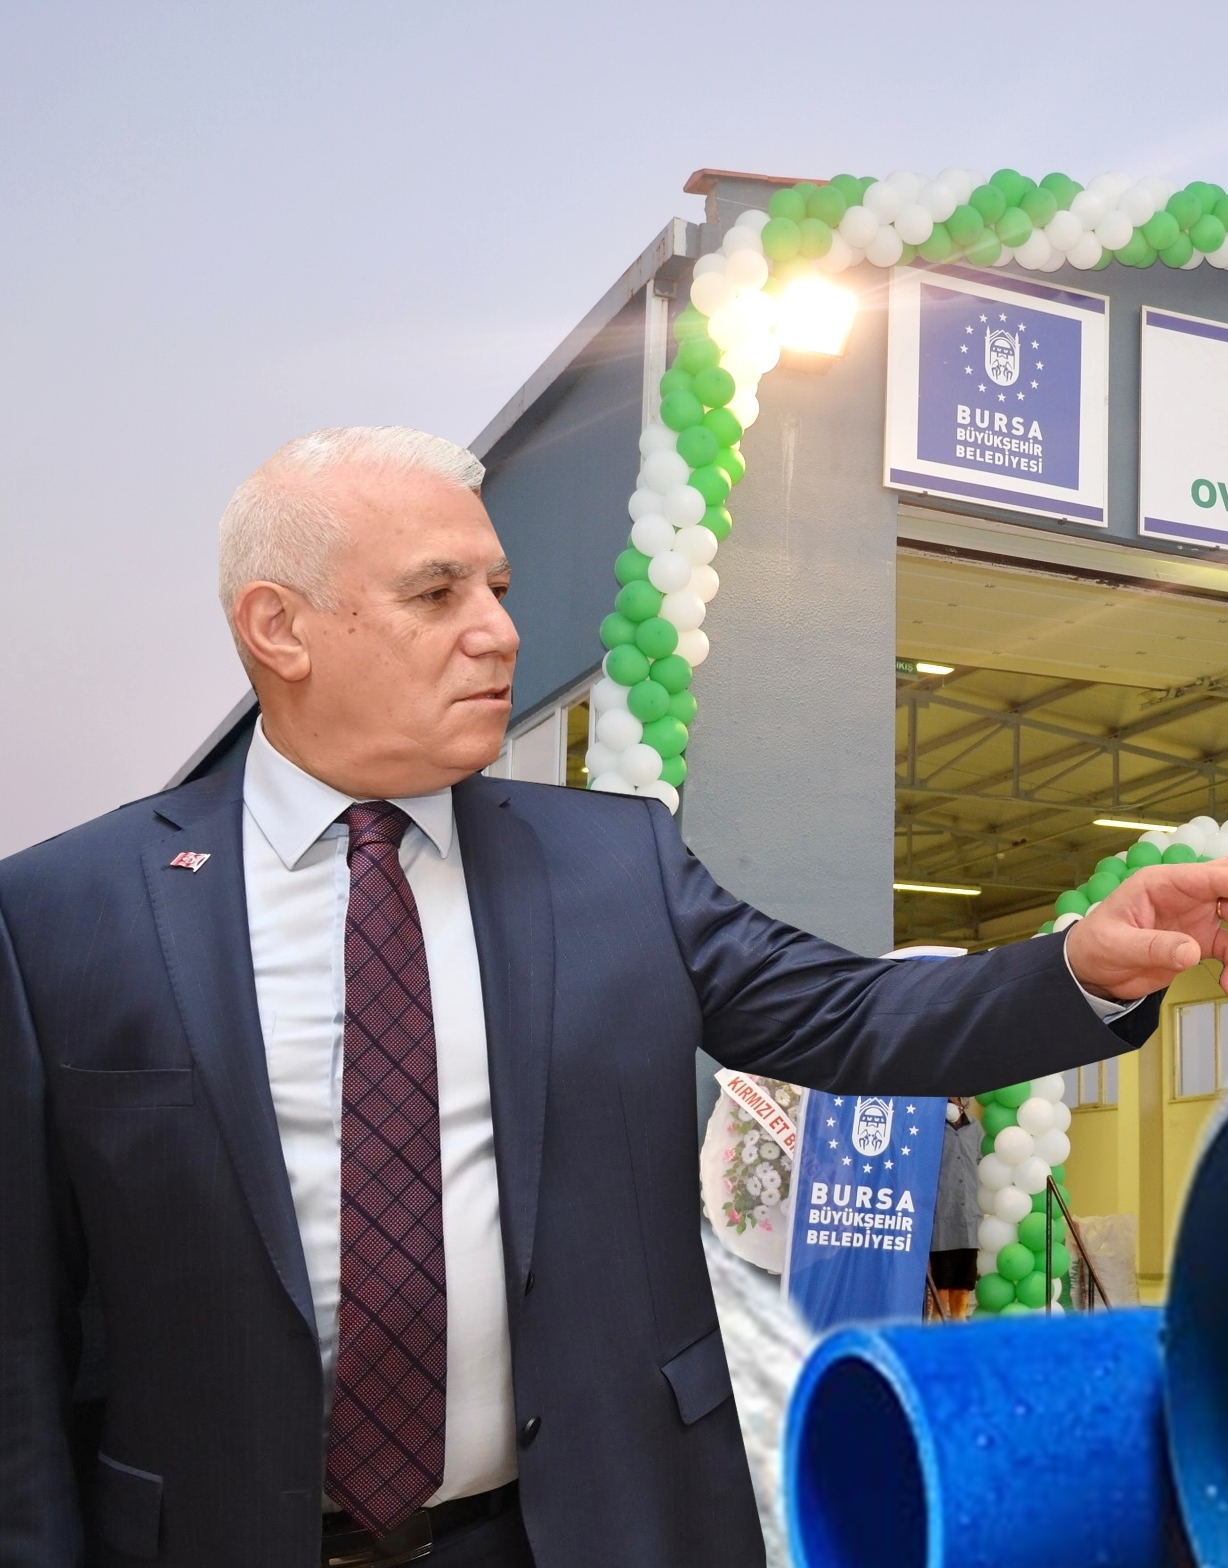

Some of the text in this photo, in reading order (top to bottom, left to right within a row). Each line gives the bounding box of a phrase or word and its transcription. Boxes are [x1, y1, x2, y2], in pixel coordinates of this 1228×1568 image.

[956, 404, 1043, 441] BURSA
[956, 426, 1043, 457] BÜYÜKŞEHİR
[956, 445, 1043, 474] BELEDİYESİ
[896, 661, 914, 673] IKIŞ
[727, 1076, 776, 1120] KIRMIZI
[768, 1115, 791, 1135] ET
[810, 1181, 915, 1213] BURSA
[808, 1208, 913, 1232] BÜYÜKŞEHİR
[806, 1226, 912, 1252] BELEDİYESİ
